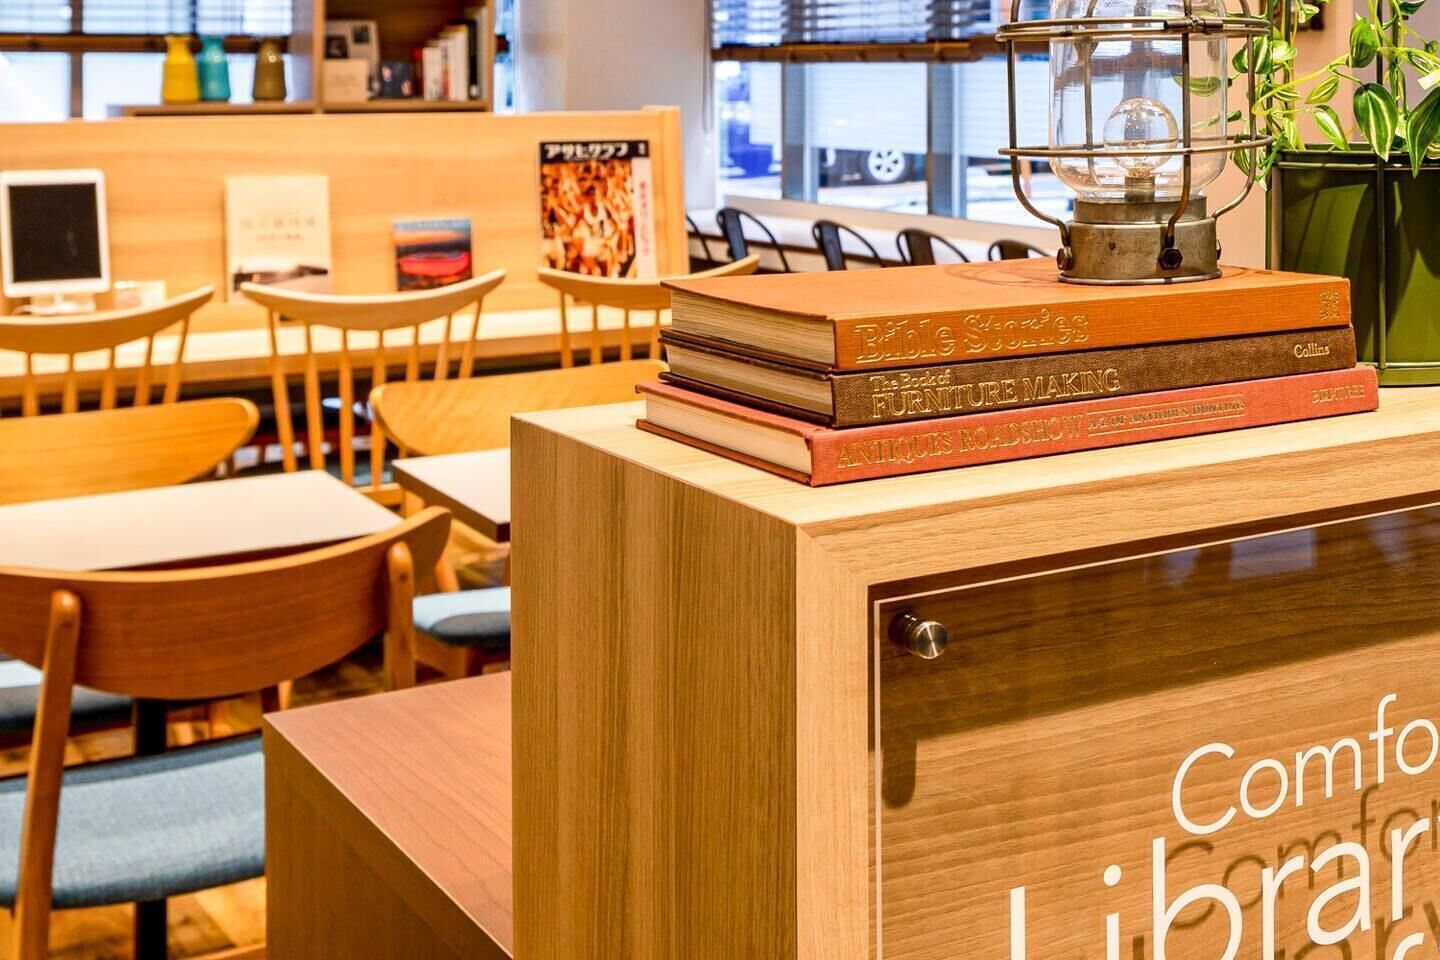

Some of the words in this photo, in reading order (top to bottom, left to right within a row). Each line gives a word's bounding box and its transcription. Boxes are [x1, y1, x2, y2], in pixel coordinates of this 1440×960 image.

[854, 318, 957, 365] Bible
[962, 307, 1091, 355] Stories
[1293, 342, 1331, 359] Collins
[869, 376, 900, 392] The
[902, 370, 937, 389] Book
[937, 368, 952, 385] of
[871, 378, 1018, 419] FURNITURE
[1022, 367, 1122, 403] MAKING
[837, 432, 954, 470] ANTIQUES
[959, 414, 1085, 454] ROADSHOW
[1111, 414, 1127, 427] OF
